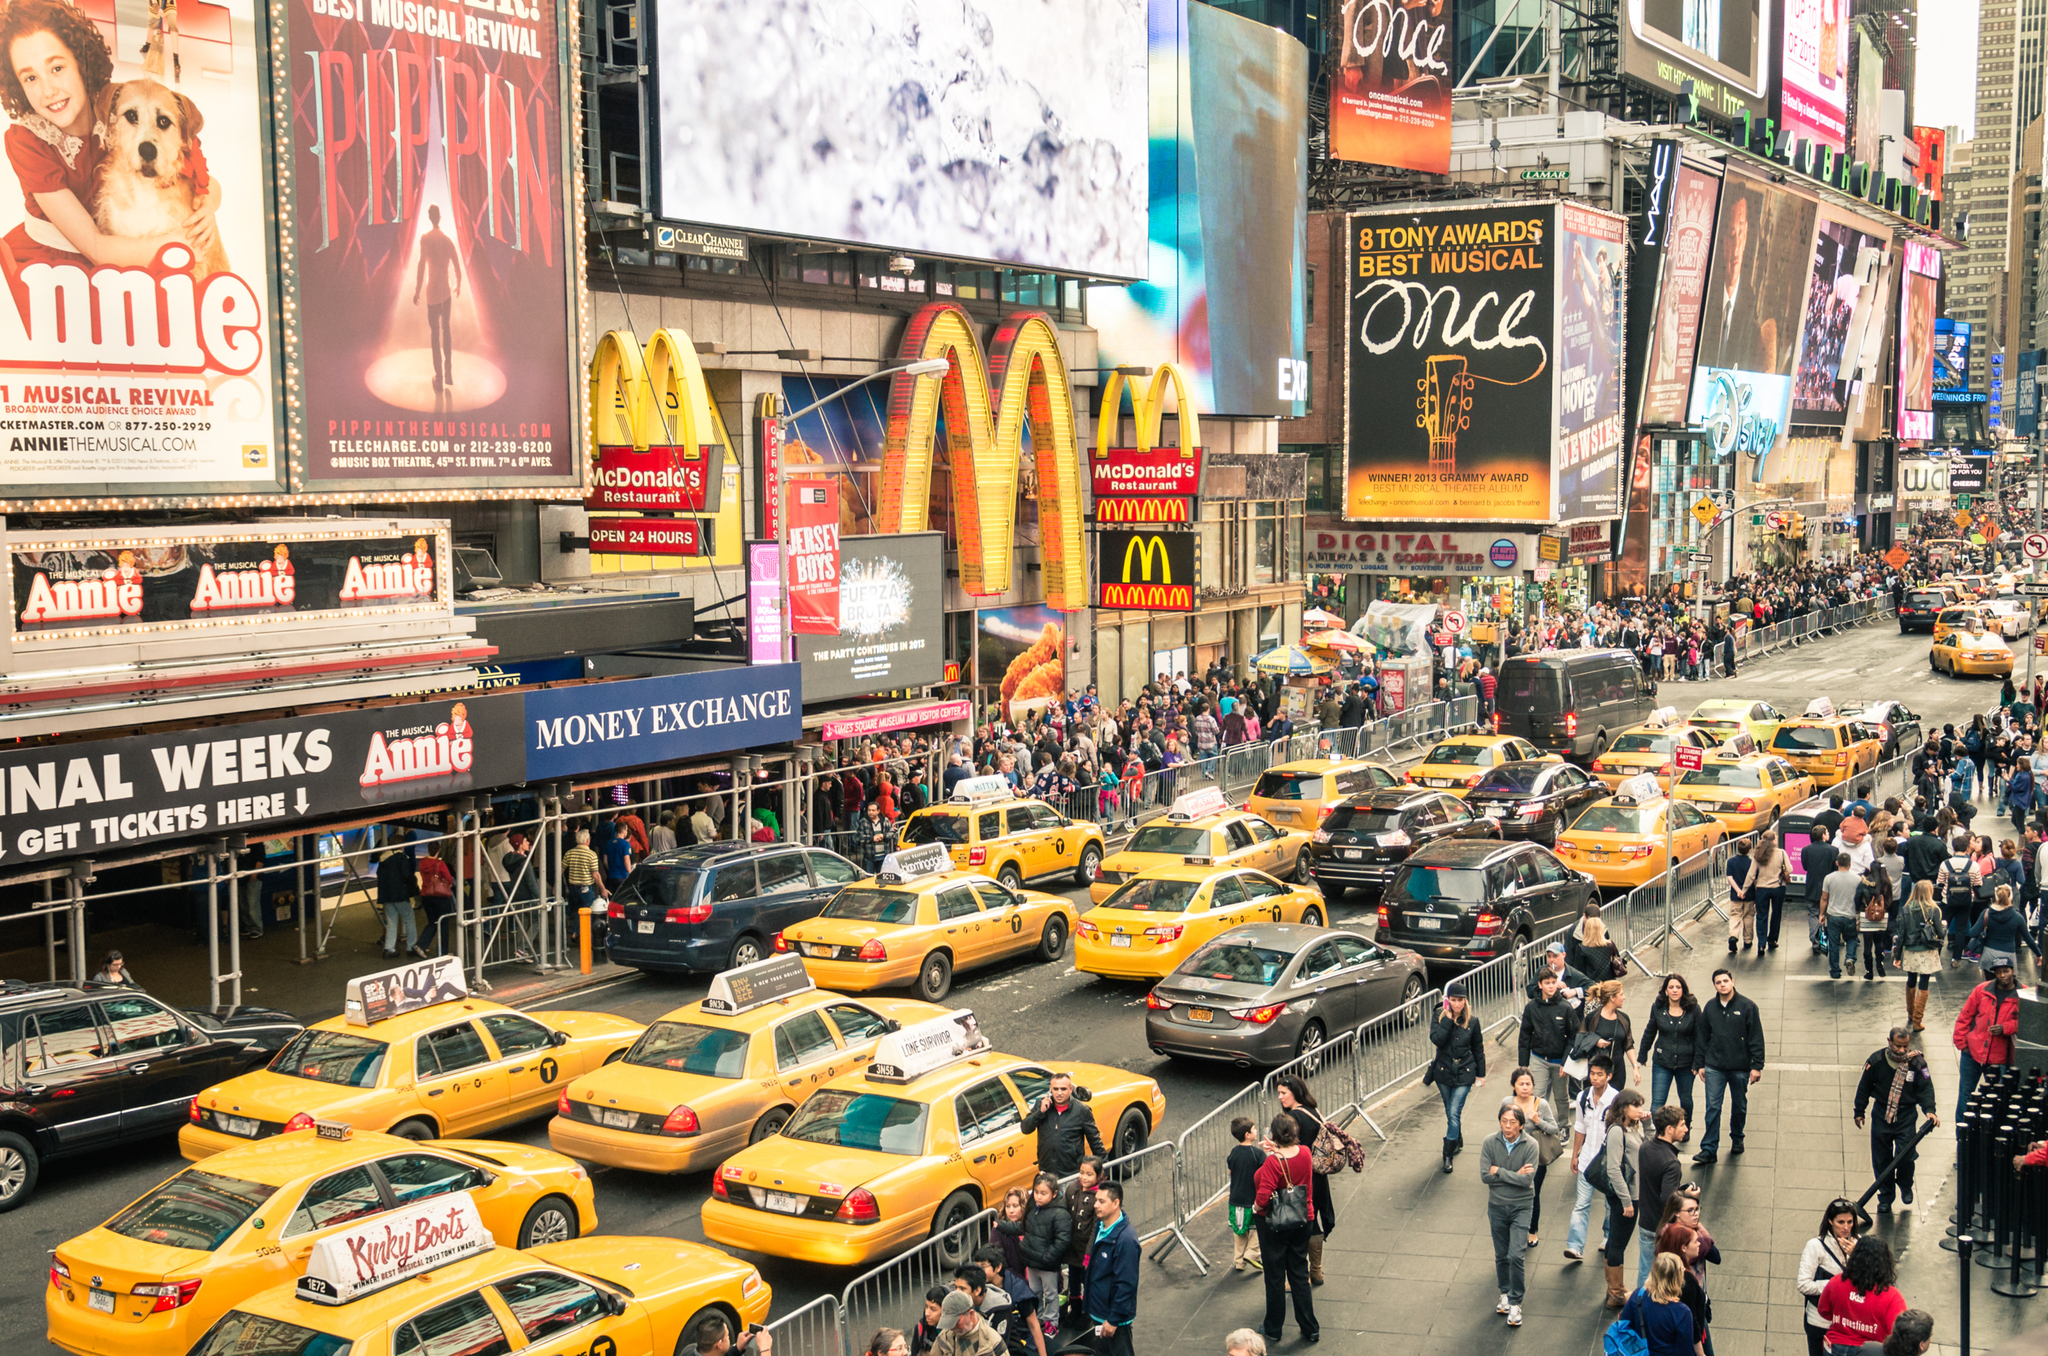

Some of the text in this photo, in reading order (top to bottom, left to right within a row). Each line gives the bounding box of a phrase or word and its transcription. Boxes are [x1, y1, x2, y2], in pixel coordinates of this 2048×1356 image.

[371, 0, 461, 43] MUSICAL
[464, 15, 541, 58] REVIVAL
[1799, 38, 1816, 67] 2013
[1657, 60, 1673, 82] VISIT
[304, 48, 553, 268] PIPPIN
[1359, 219, 1543, 250] 8 TONY AWARDS
[703, 245, 744, 257] SPECTACOLOR
[1412, 244, 1487, 252] INCLUDING
[1359, 248, 1543, 277] BEST MUSICAL
[1676, 251, 1697, 268] COMET
[1561, 364, 1586, 386] NOTHING
[23, 385, 214, 406] MUSICAL REVIVAL
[1561, 374, 1597, 416] MOVES
[5, 405, 197, 416] BROADWAY.COM AUDIENCE CHOICE AWARD
[1584, 404, 1596, 423] LIKE
[108, 421, 212, 431] OR 877-250-2929
[328, 420, 552, 438] PIPPINTHEMUSICAL.COM
[10, 437, 197, 452] ANNIETHEMUSICAL.COM
[329, 440, 552, 453] TELECHARGE.COM or 212-239-6200
[769, 425, 778, 469] OPEN
[1559, 413, 1620, 471] NEWSIES
[338, 457, 370, 468] MUSIC
[372, 457, 390, 467] BOX
[393, 457, 435, 469] THEATRE,
[470, 457, 497, 467] BTWN.
[511, 458, 517, 467] &
[531, 457, 552, 467] AVES.
[1095, 463, 1194, 479] McDonald's
[591, 467, 700, 488] McDonald's
[1368, 473, 1412, 482] WINNER!
[1414, 473, 1437, 482] 2013
[1490, 473, 1529, 482] AWARD
[1581, 465, 1591, 482] ON
[1111, 481, 1178, 490] Restaurant
[1373, 484, 1523, 493] BEST MUSICAL THEATER ALBUM
[604, 490, 681, 503] Restaurant
[1493, 499, 1515, 508] jacobs
[771, 486, 779, 540] HOURS
[591, 530, 692, 544] OPEN 24 HOURS
[789, 522, 839, 557] JERSEY
[1317, 533, 1459, 550] DIGITAL
[214, 560, 258, 570] THE MUSICAL
[361, 554, 400, 563] THE MUSICAL
[1376, 552, 1485, 564] & COMPUTERS
[1491, 553, 1516, 561] LUGGAGE
[49, 570, 100, 580] THE MUSICAL
[340, 553, 433, 600] Annie
[796, 552, 836, 583] BOYS
[190, 560, 296, 611] Annie
[840, 582, 898, 603] FUERZA
[21, 569, 144, 623] Annie
[848, 603, 892, 621] BRUTA
[813, 639, 925, 661] THE PARTY CONTINUES IN 2013
[536, 688, 792, 750] MONEY EXCHANGE
[834, 706, 962, 735] TIMES SQUARE MUSEUM AND VISITOR CENTER
[386, 725, 434, 739] THE MUSICAL
[151, 728, 333, 792] WEEKS
[359, 723, 474, 787] Annie
[1679, 753, 1699, 761] ANYTIME
[974, 780, 995, 792] MITTY
[17, 793, 285, 856] GET TICKETS HERE
[759, 978, 770, 987] NEW
[771, 973, 783, 983] YORK
[784, 968, 804, 979] HOLIDAY
[363, 980, 385, 994] epix
[708, 999, 725, 1010] 9N36
[902, 1029, 953, 1058] LONE SURVIVOR
[876, 1063, 894, 1077] 3N58
[414, 1207, 470, 1254] Boots
[346, 1223, 413, 1281] Kinky
[352, 1240, 476, 1291] WINNER! BEST MUSICAL 2013 TONY AWARD
[307, 1278, 326, 1293] 1E72
